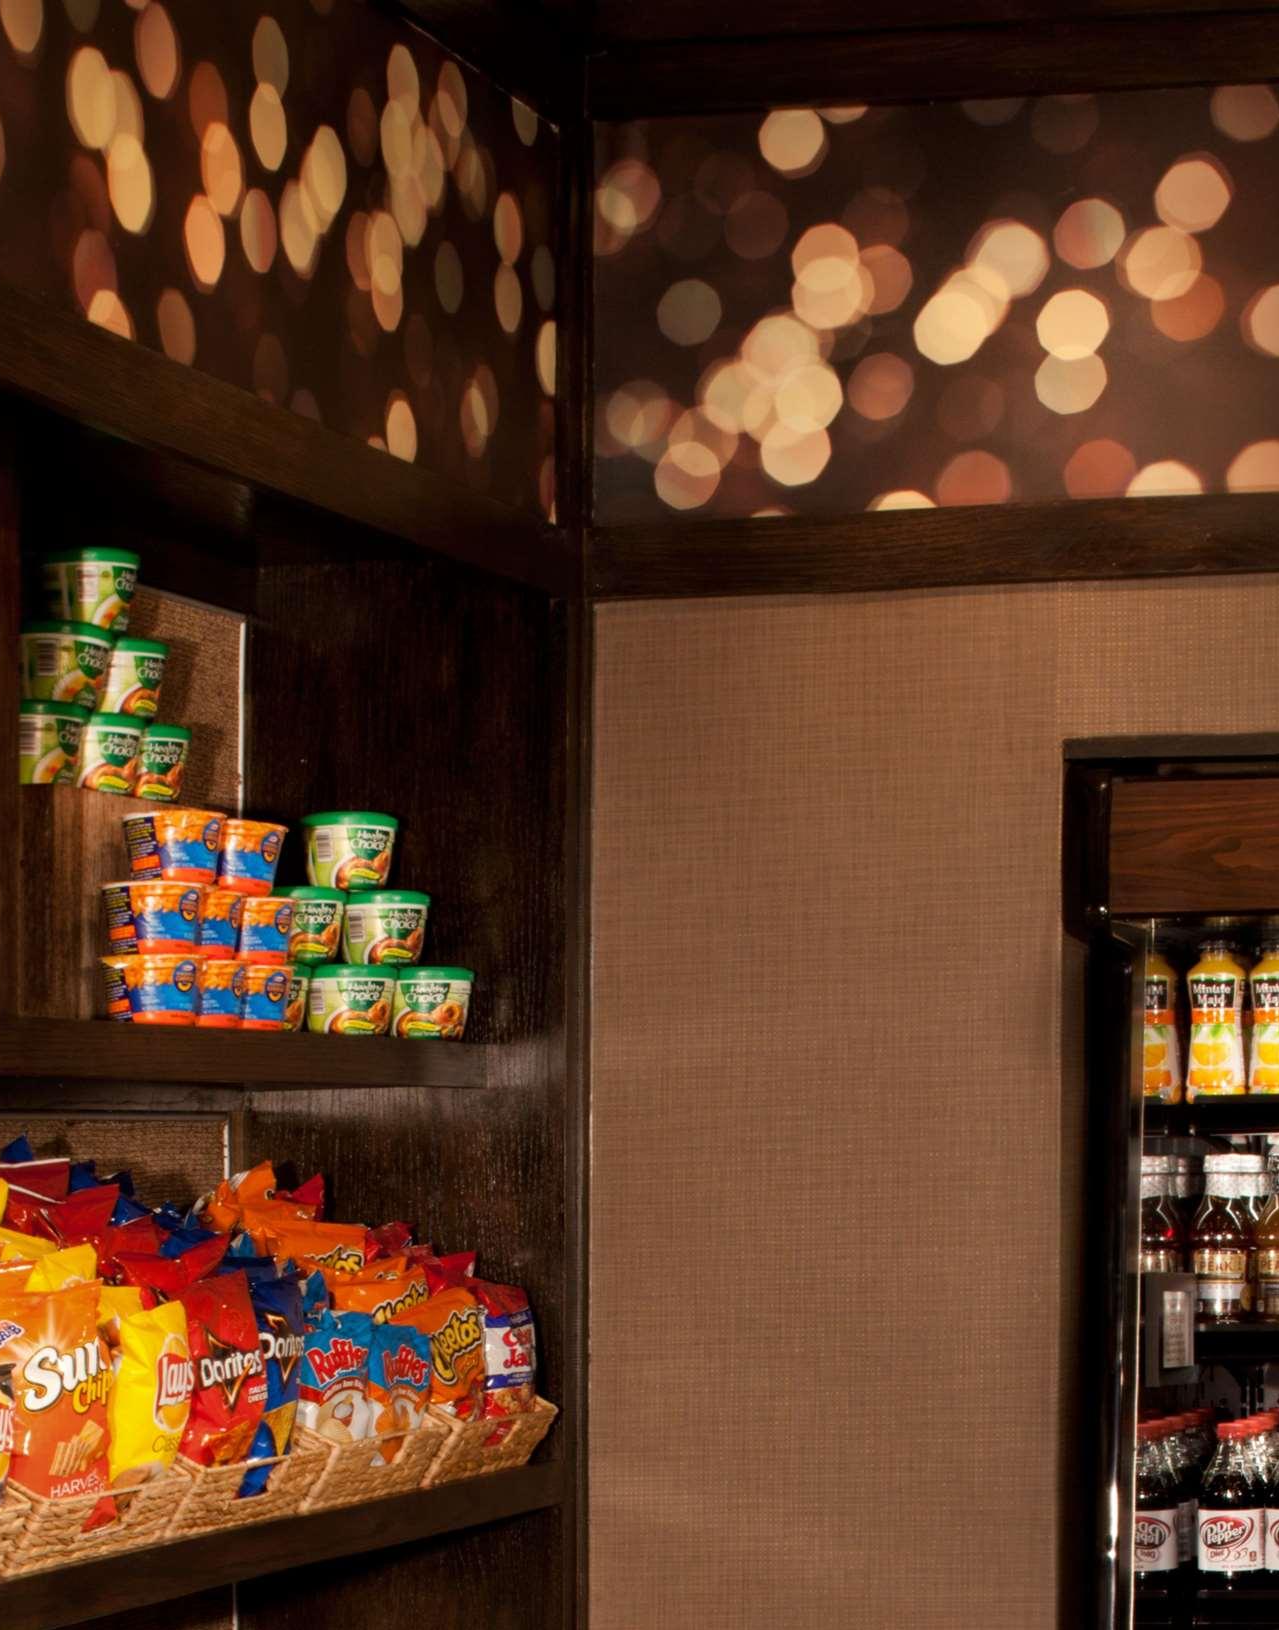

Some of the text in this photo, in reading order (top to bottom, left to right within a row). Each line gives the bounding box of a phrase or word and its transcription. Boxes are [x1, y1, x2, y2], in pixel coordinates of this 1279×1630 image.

[351, 839, 386, 850] Choice
[306, 1339, 368, 1386] Ruffles
[383, 1345, 429, 1386] Ruffles
[432, 1307, 485, 1384] Cheetos
[24, 1337, 106, 1411] Sun
[199, 1349, 263, 1388] Doritos
[1205, 1523, 1246, 1546] Pepper
[1220, 1519, 1234, 1532] Dr
